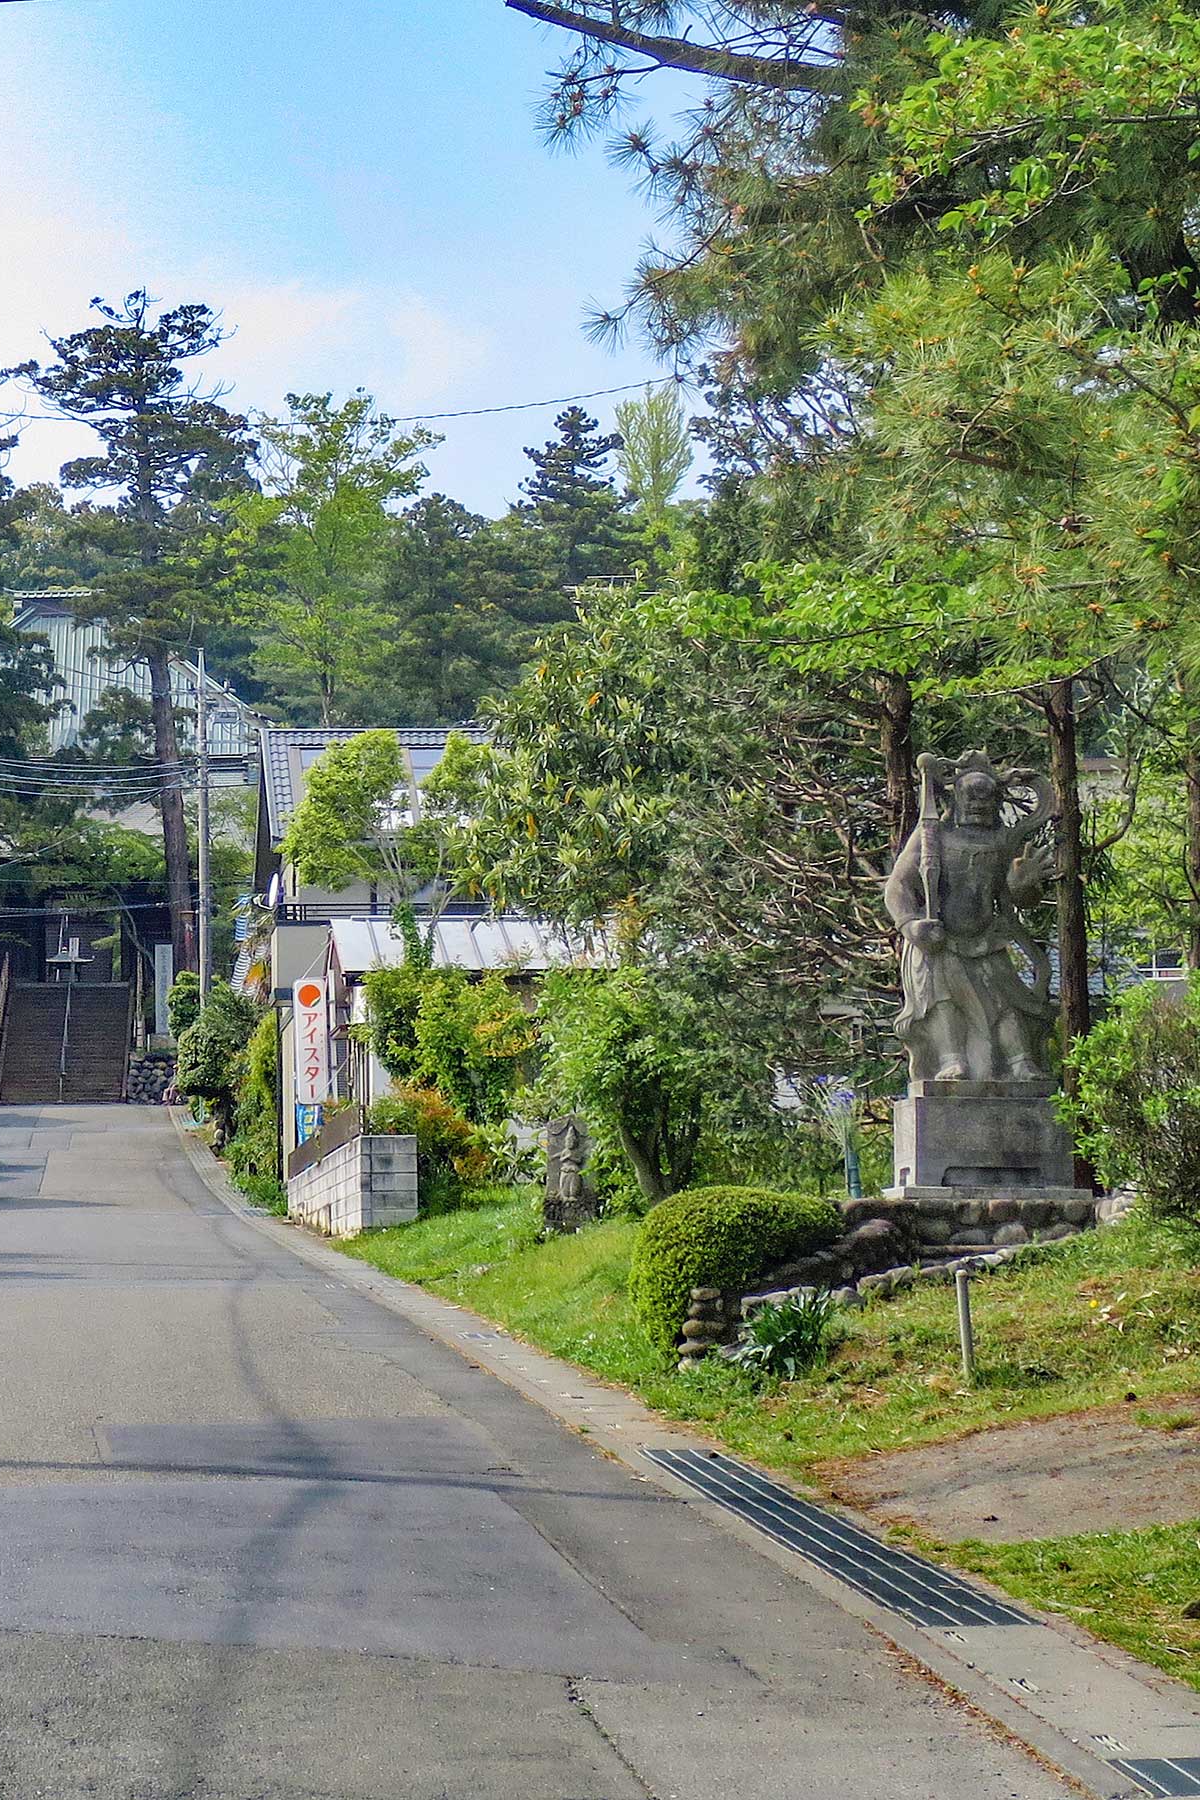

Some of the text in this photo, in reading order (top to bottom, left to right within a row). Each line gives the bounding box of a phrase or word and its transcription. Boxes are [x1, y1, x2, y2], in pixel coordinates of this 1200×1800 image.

[301, 1012, 320, 1098] アイスター
